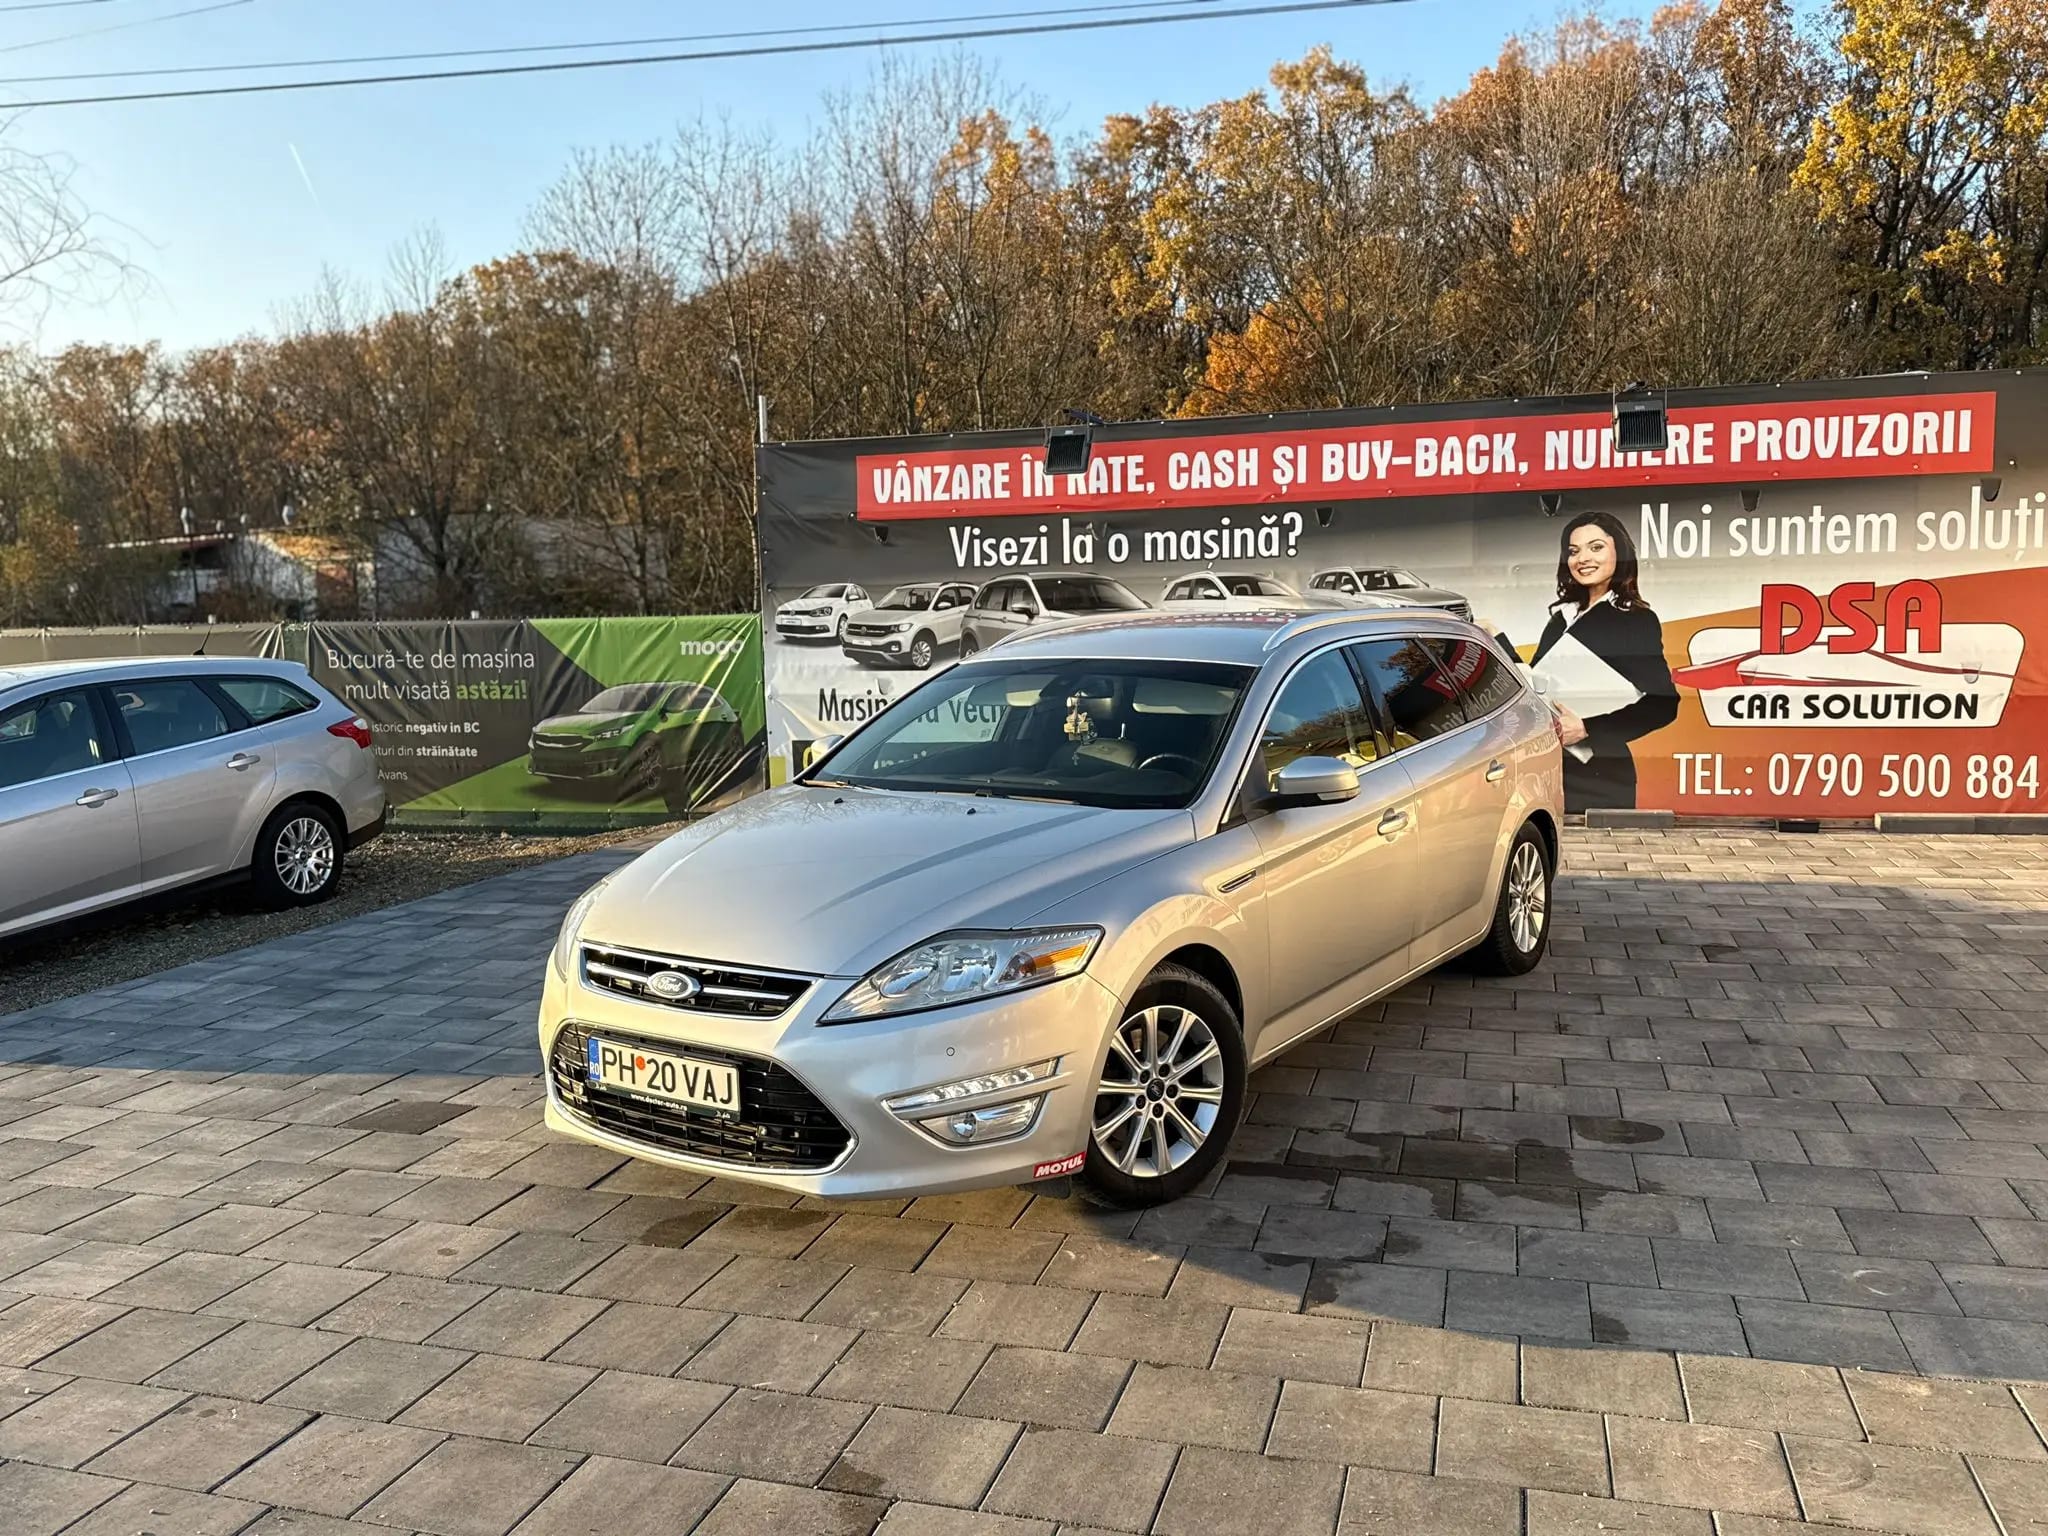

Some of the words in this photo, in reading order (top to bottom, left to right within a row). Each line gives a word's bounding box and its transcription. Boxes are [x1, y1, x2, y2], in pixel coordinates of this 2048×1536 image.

[873, 460, 1010, 503] VÂNZARE
[1168, 447, 1258, 490] CASH
[1272, 445, 1307, 494] ȘI
[1321, 432, 1529, 482] BUY-BACK,
[1730, 409, 1972, 463] PROVIZORII
[949, 524, 1048, 568] Visezi
[1062, 518, 1094, 564] la
[1107, 532, 1129, 563] o
[1143, 511, 1304, 570] mașină?
[1640, 503, 1713, 559] Noi
[1728, 505, 1898, 558] suntem
[1760, 578, 1943, 656] DSA
[327, 648, 424, 669] Bucură-te
[430, 648, 456, 669] de
[461, 648, 535, 673] mașina
[345, 680, 391, 700] mult
[394, 680, 451, 700] visată
[456, 680, 528, 700] astăzi!
[818, 687, 898, 722] Masin
[1727, 693, 1790, 720] CAR
[1802, 692, 1979, 720] SOLUTION
[405, 721, 447, 736] negativ
[463, 721, 481, 734] BC
[397, 744, 414, 757] din
[416, 745, 478, 758] străinătate
[377, 768, 409, 781] Avans
[1672, 753, 1753, 796] TEL.:
[1768, 752, 1863, 797] 0790
[1878, 753, 1951, 798] 500
[1966, 754, 2040, 799] 884
[656, 976, 682, 992] Ford
[589, 1061, 600, 1076] RO
[602, 1046, 636, 1085] PH
[646, 1057, 676, 1093] 20
[682, 1064, 733, 1104] VAJ
[1035, 1154, 1083, 1177] MOTUL
